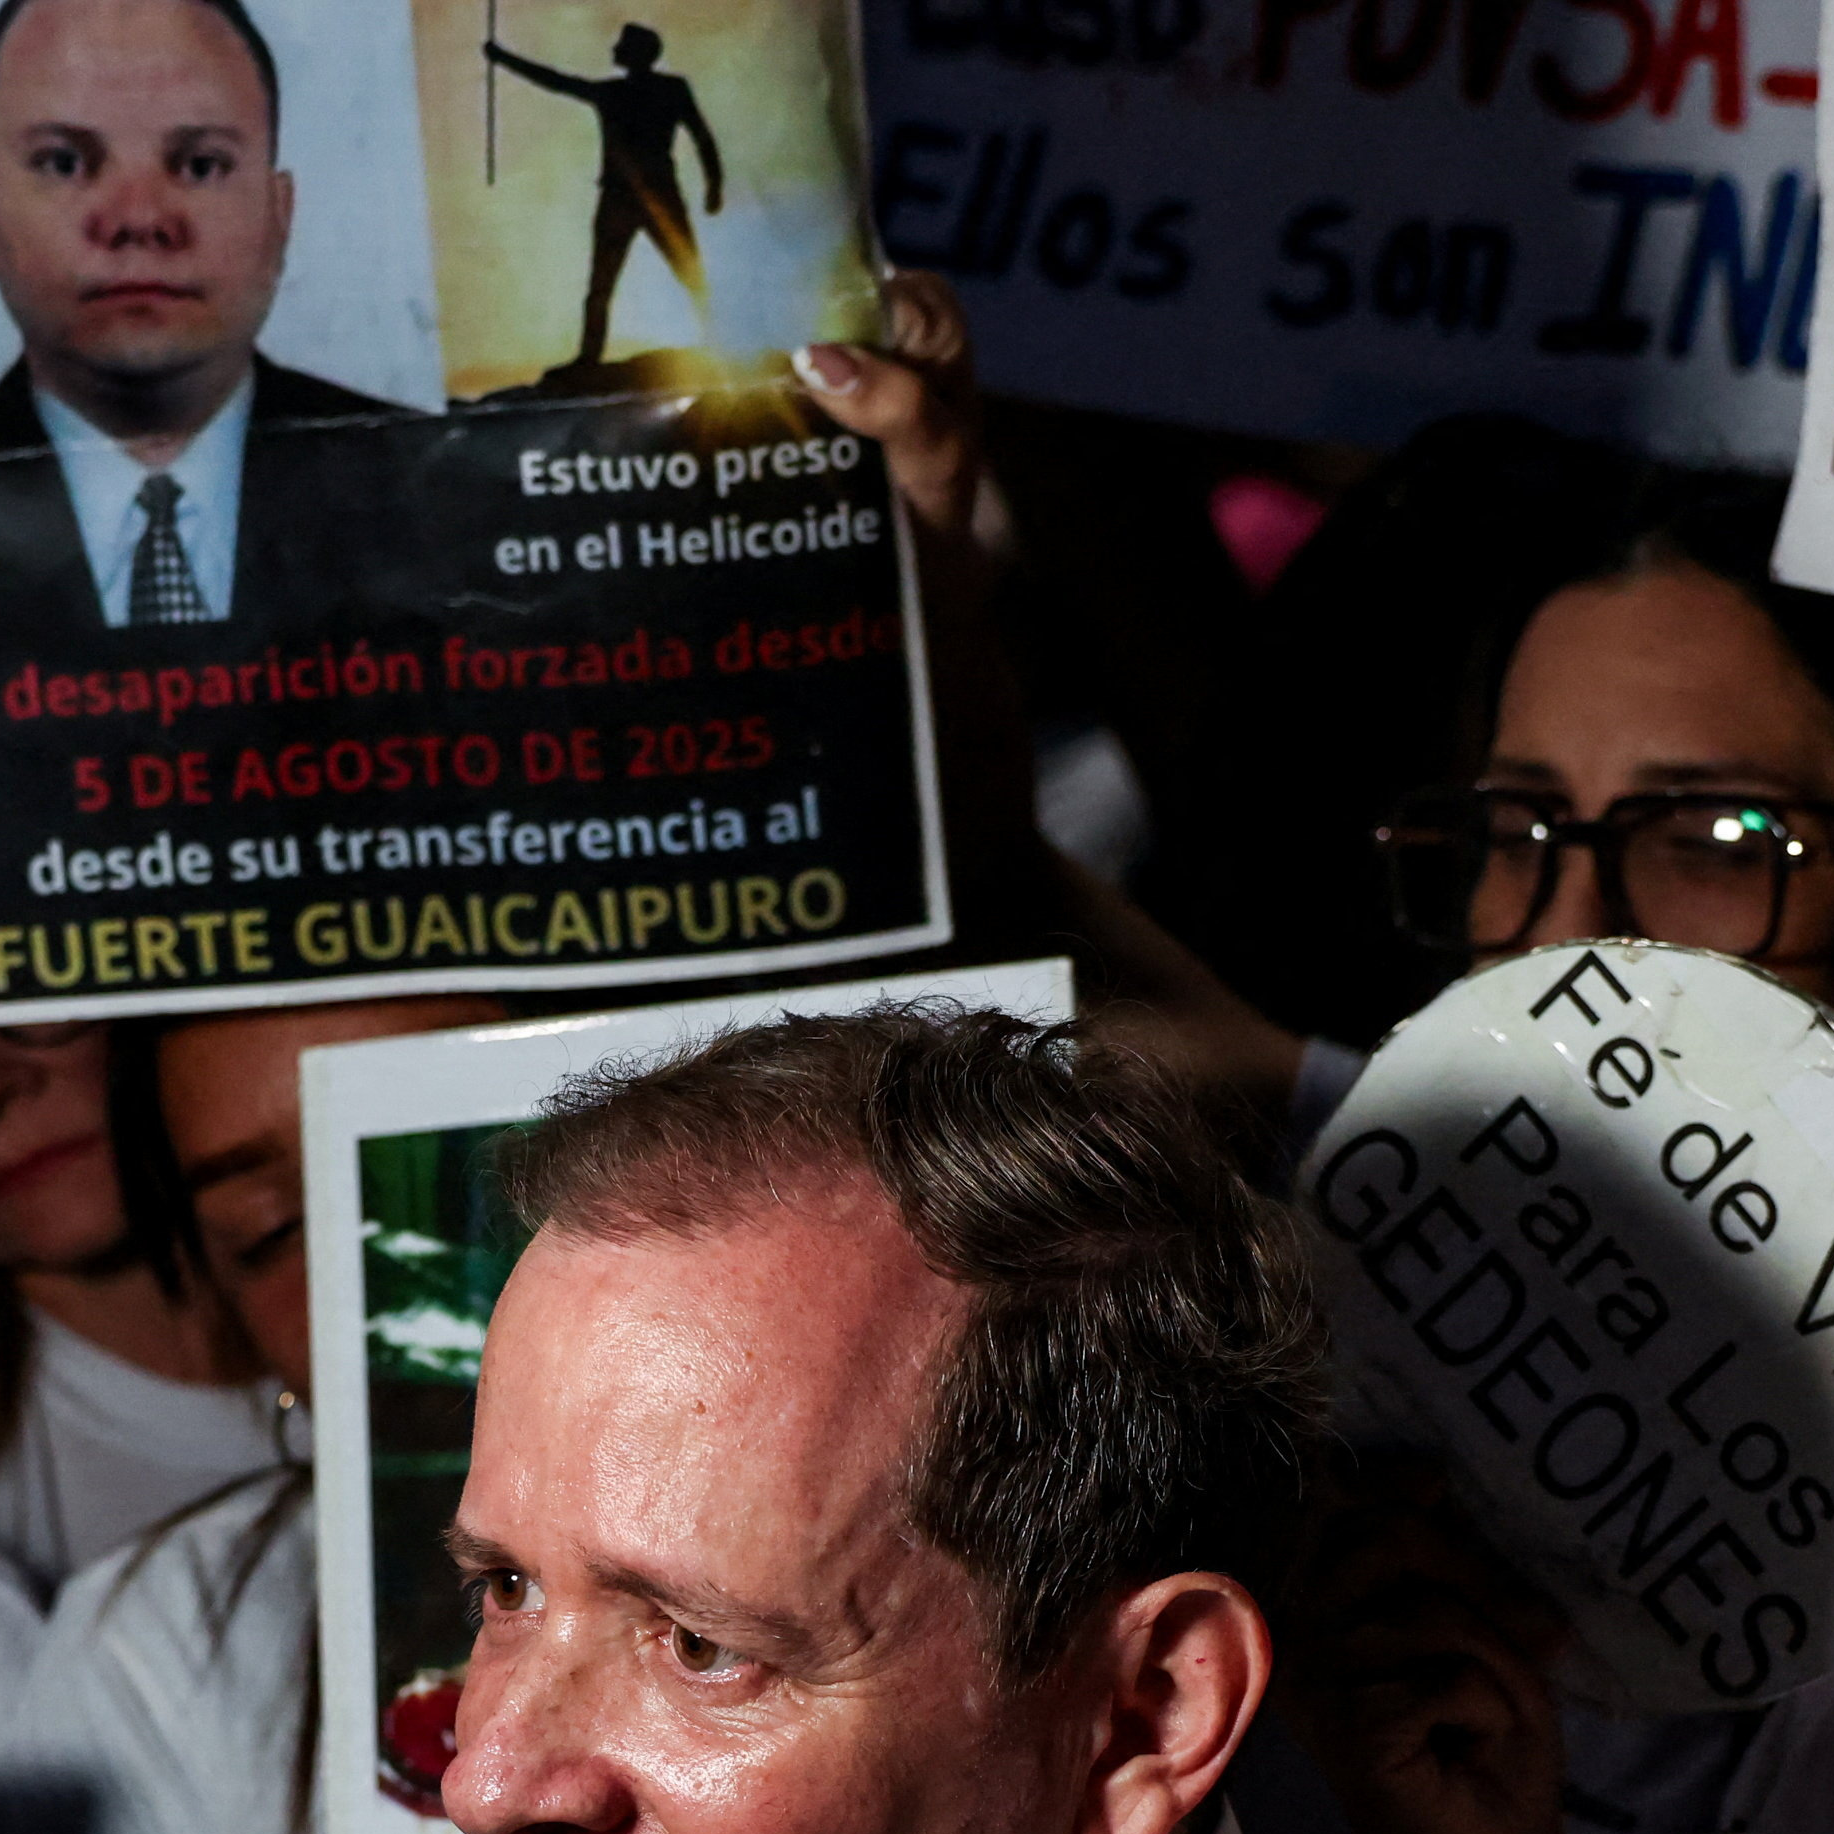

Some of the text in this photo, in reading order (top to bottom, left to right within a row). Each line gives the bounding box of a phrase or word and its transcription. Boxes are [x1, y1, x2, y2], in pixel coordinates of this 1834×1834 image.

[876, 119, 1195, 300] Ellos
[517, 433, 862, 500] Estuvo preso
[493, 502, 882, 576] en el Helicoide
[0, 637, 425, 727] desaparición
[442, 625, 694, 693] forzada
[72, 714, 777, 813] 5 DE AGOSTO DE 2025
[26, 783, 823, 898] desde su transferencia al
[291, 864, 849, 968] GUAICAIPURO
[1530, 949, 1683, 1110] Fé
[1659, 1121, 1779, 1256] de
[1459, 1095, 1671, 1356] Para
[1315, 1128, 1808, 1699] GEDEONES
